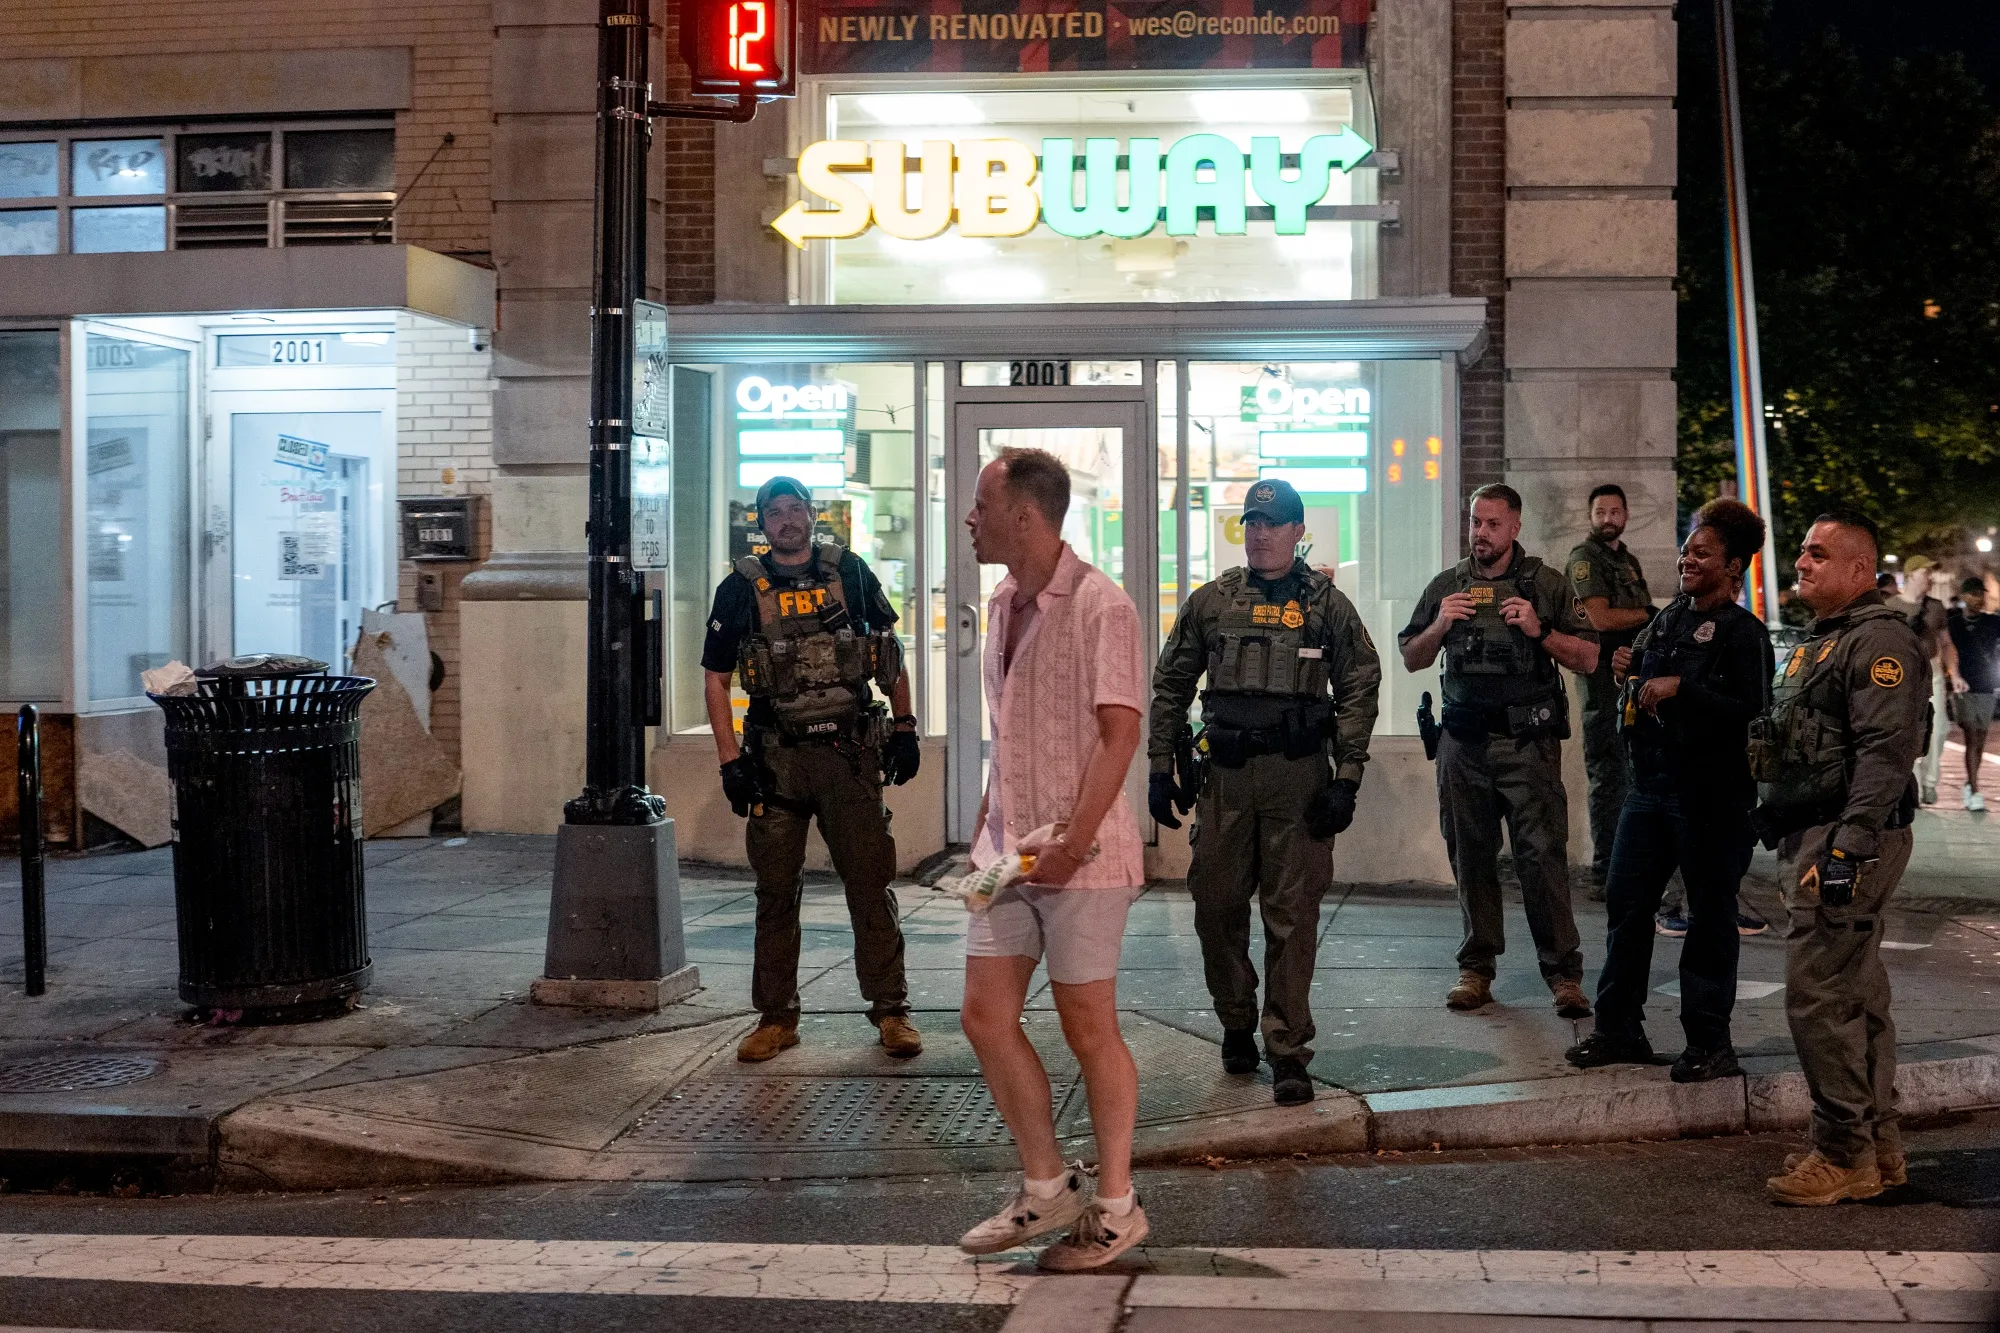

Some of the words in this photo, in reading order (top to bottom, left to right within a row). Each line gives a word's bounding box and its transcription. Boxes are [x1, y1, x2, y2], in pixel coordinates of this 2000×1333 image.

[728, 2, 765, 72] 12
[818, 15, 918, 42] NEWLY
[929, 12, 1103, 40] RENOVATED
[1128, 10, 1339, 38] wes@recondc.com
[770, 123, 1374, 250] SUBWAY
[273, 340, 323, 363] 2001
[1010, 361, 1069, 387] 2001
[736, 376, 848, 420] Open
[1256, 380, 1371, 423] Open
[639, 497, 660, 512] YIELD
[421, 530, 450, 541] 2001
[645, 518, 655, 534] TO
[641, 541, 660, 556] PEDS
[711, 619, 722, 632] FBI
